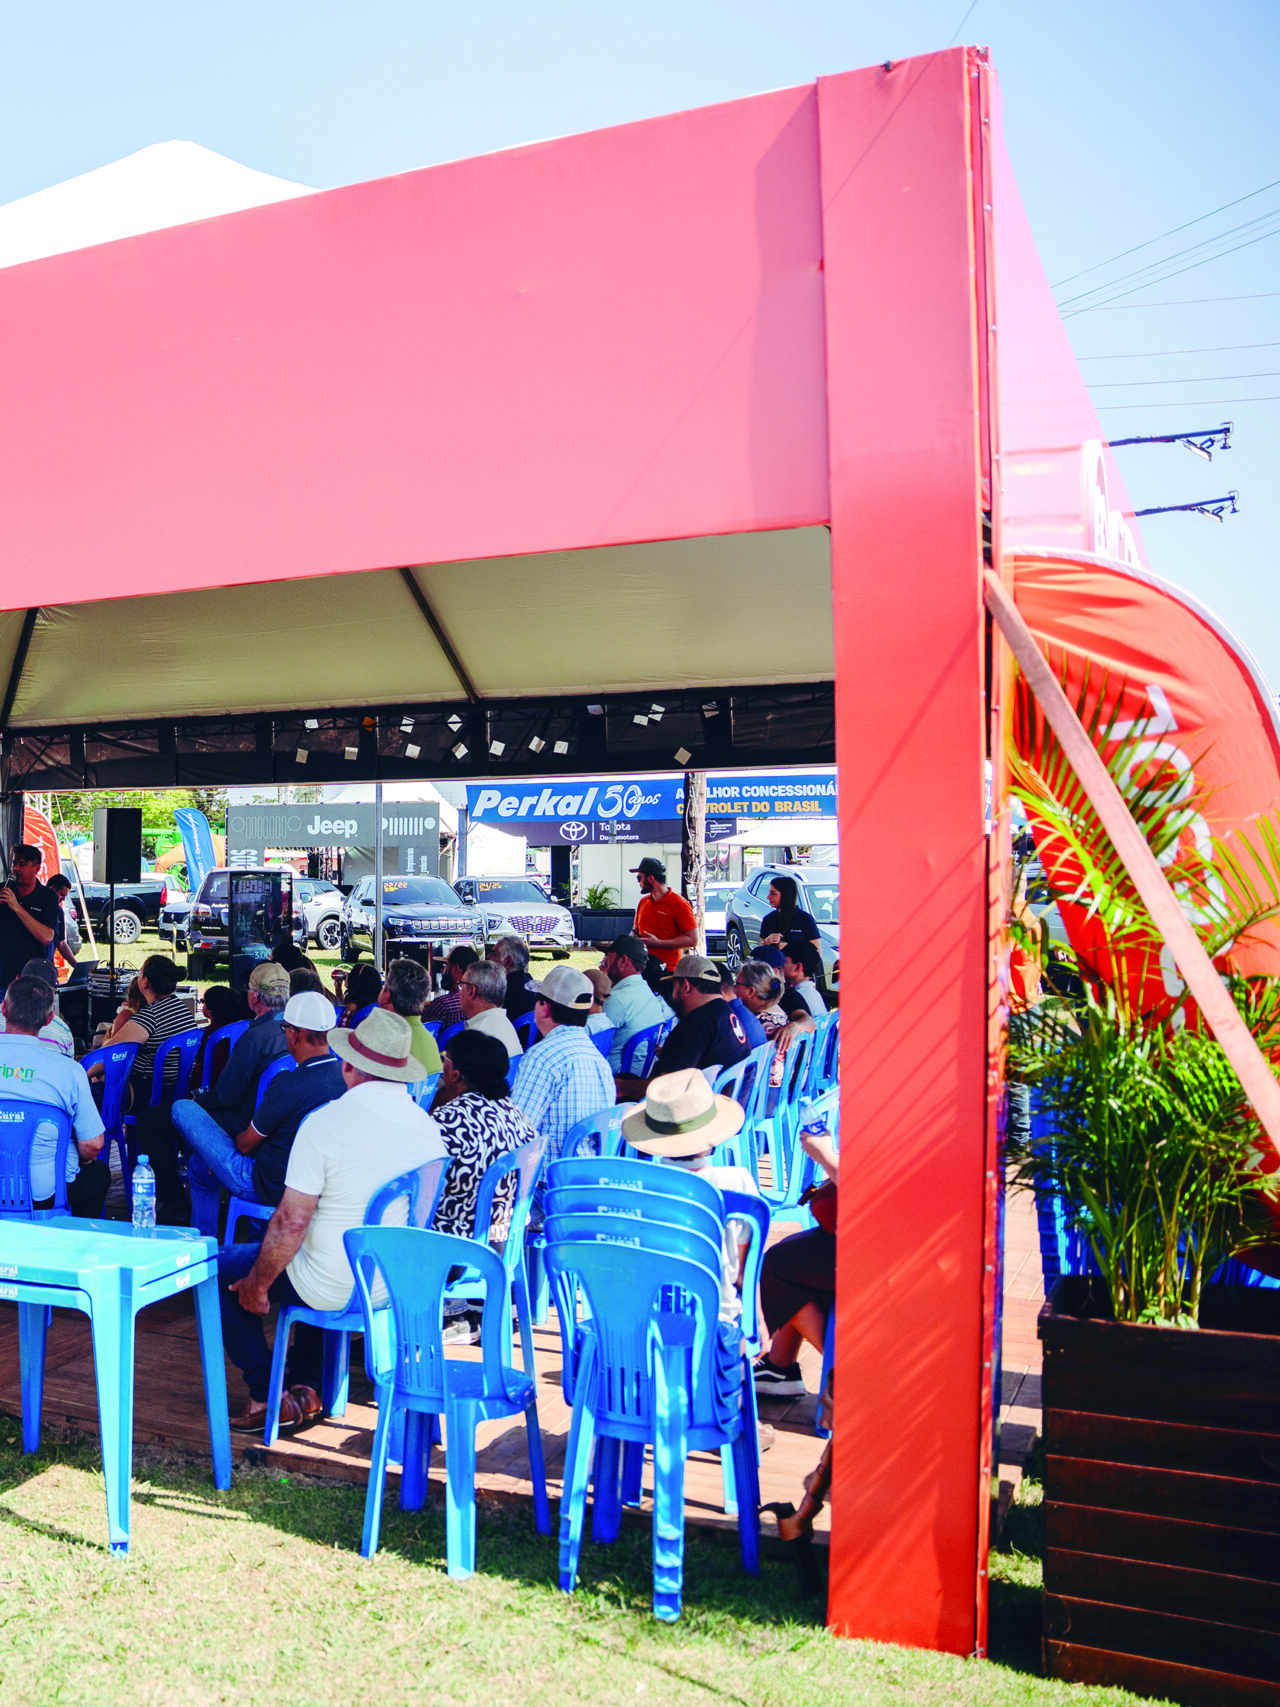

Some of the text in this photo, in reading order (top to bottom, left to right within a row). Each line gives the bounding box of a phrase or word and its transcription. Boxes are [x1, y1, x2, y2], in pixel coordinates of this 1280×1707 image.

[707, 786, 740, 798] LHOR
[742, 781, 838, 797] CONCESSIONÁ
[471, 787, 598, 818] Perkal
[597, 784, 642, 818] 50
[752, 801, 770, 812] DO
[775, 800, 822, 812] BRASIL
[307, 815, 358, 838] Jeep
[599, 822, 631, 831] Toota
